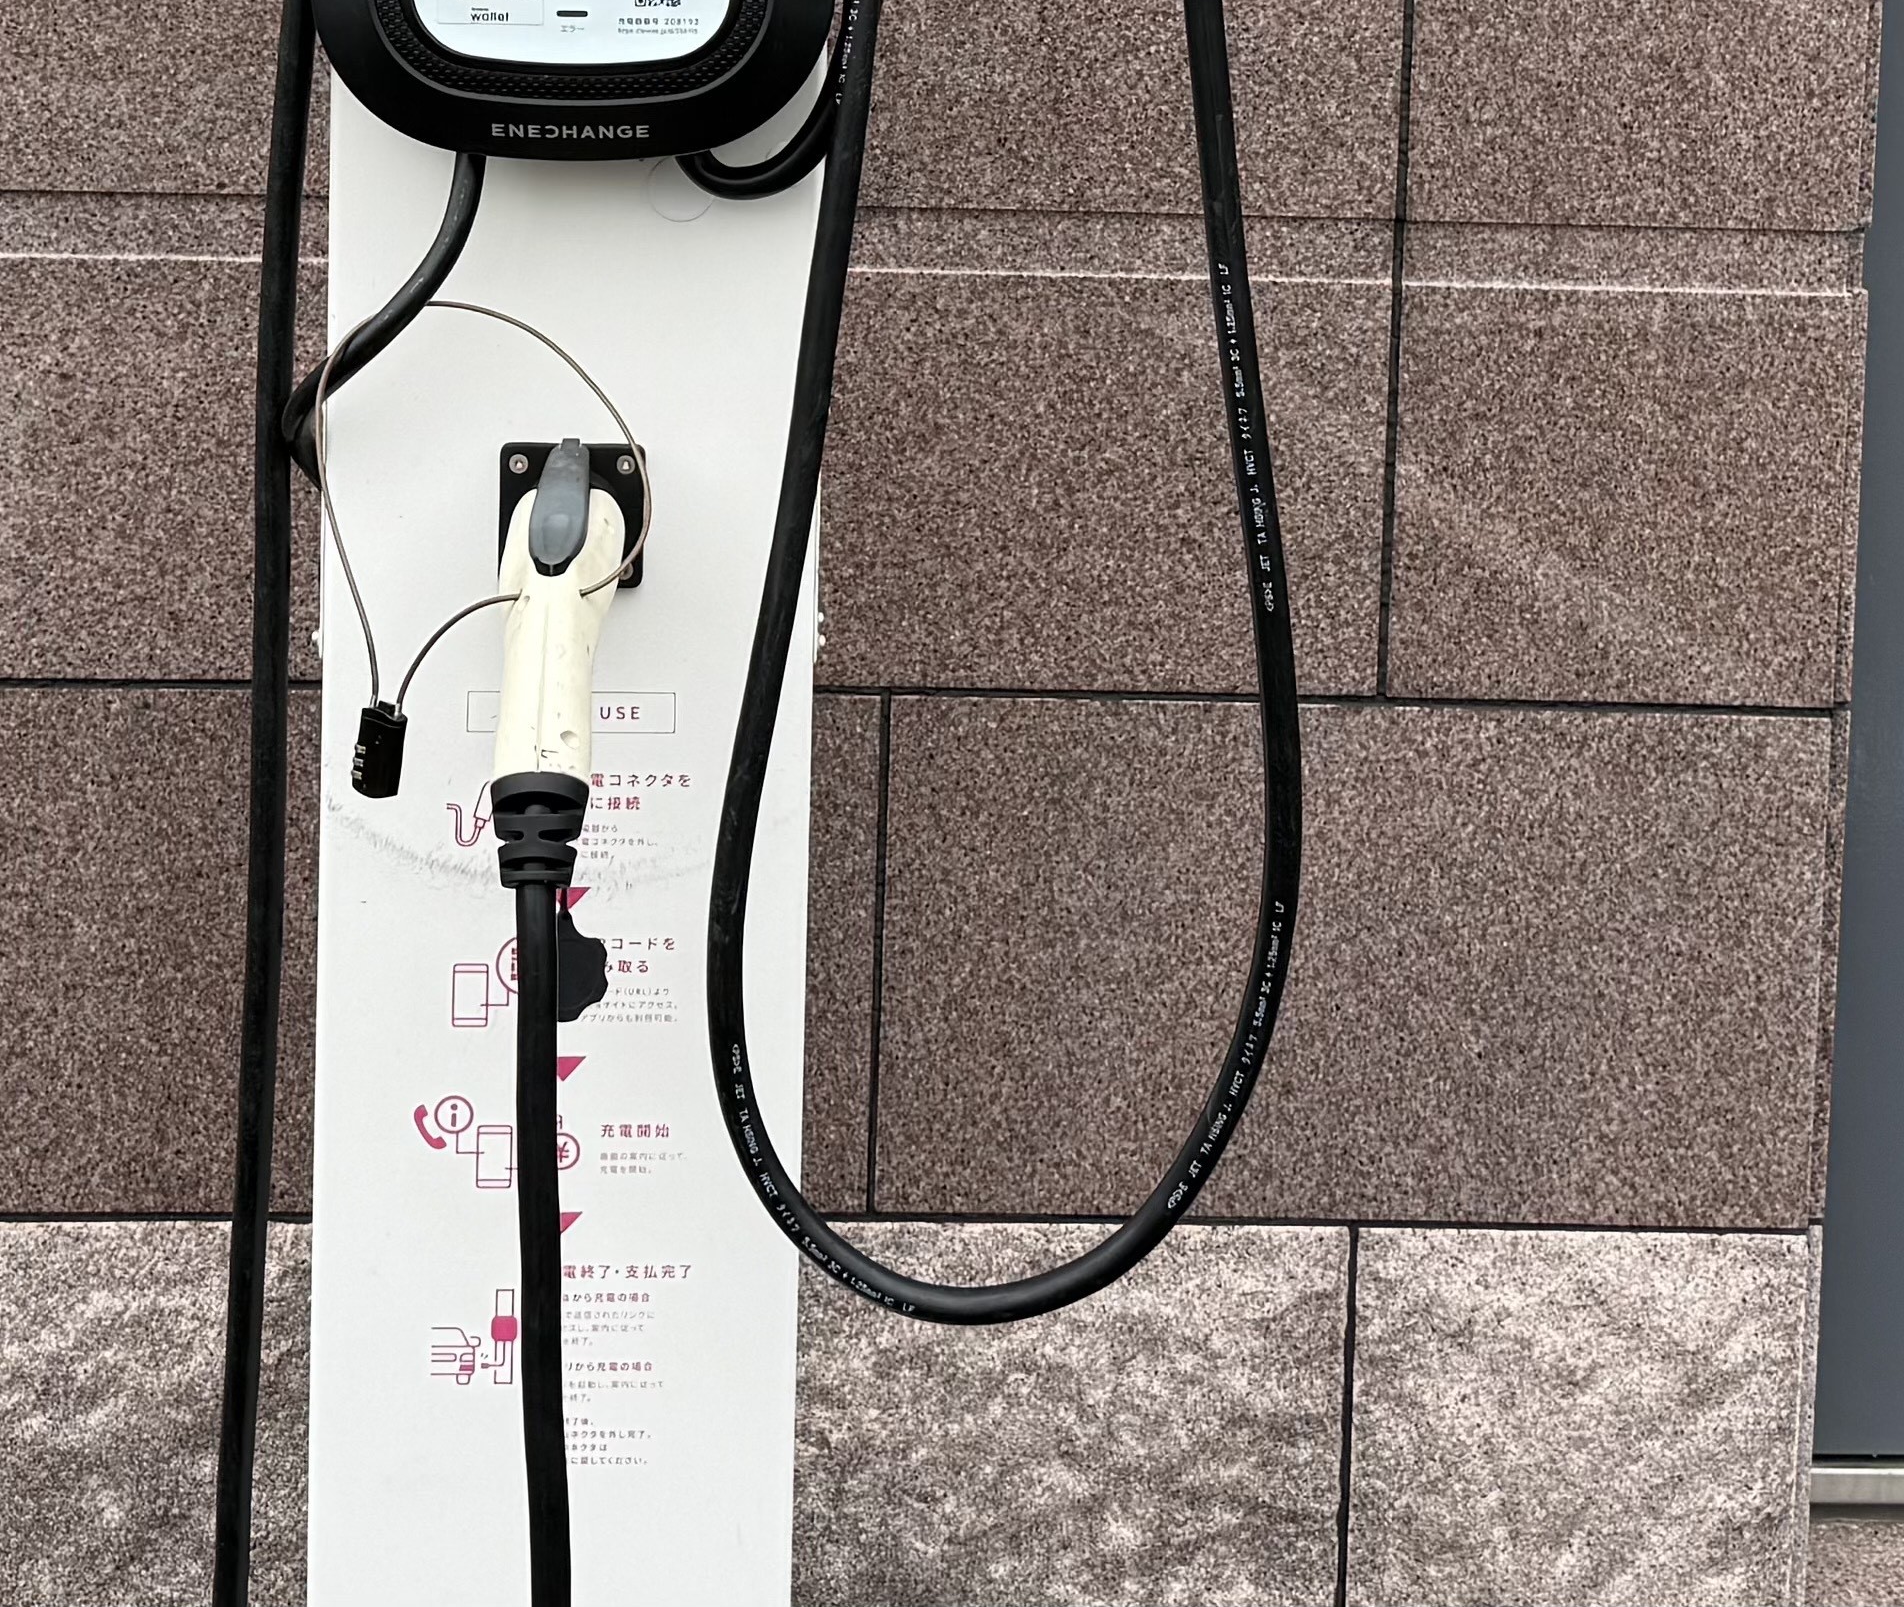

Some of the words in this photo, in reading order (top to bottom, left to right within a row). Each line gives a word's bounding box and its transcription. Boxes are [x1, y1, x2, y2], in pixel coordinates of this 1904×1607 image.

[491, 123, 650, 139] ENECHANGE
[600, 706, 640, 720] USE
[601, 1123, 670, 1138] 充電開始
